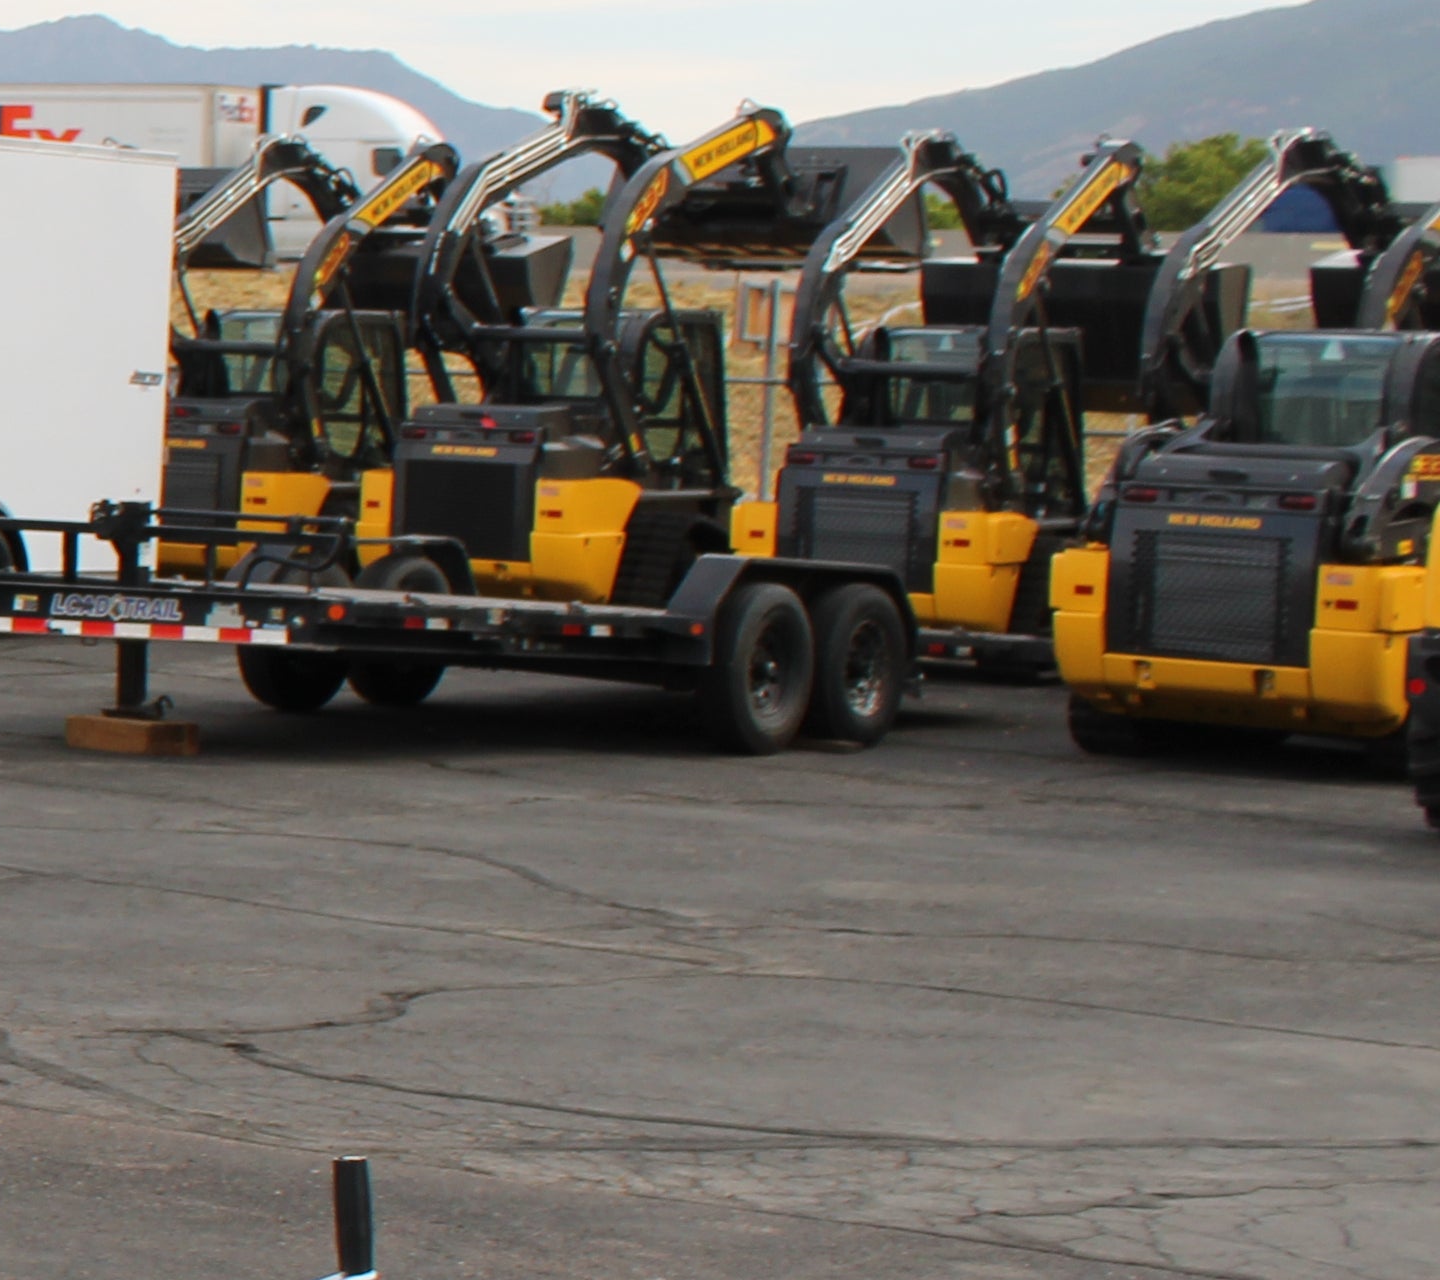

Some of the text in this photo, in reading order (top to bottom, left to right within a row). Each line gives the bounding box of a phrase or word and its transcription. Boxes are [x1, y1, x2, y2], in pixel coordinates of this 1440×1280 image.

[1199, 515, 1262, 530] HOLLAND
[50, 593, 109, 616] LOAD
[120, 596, 183, 621] TRAIL
